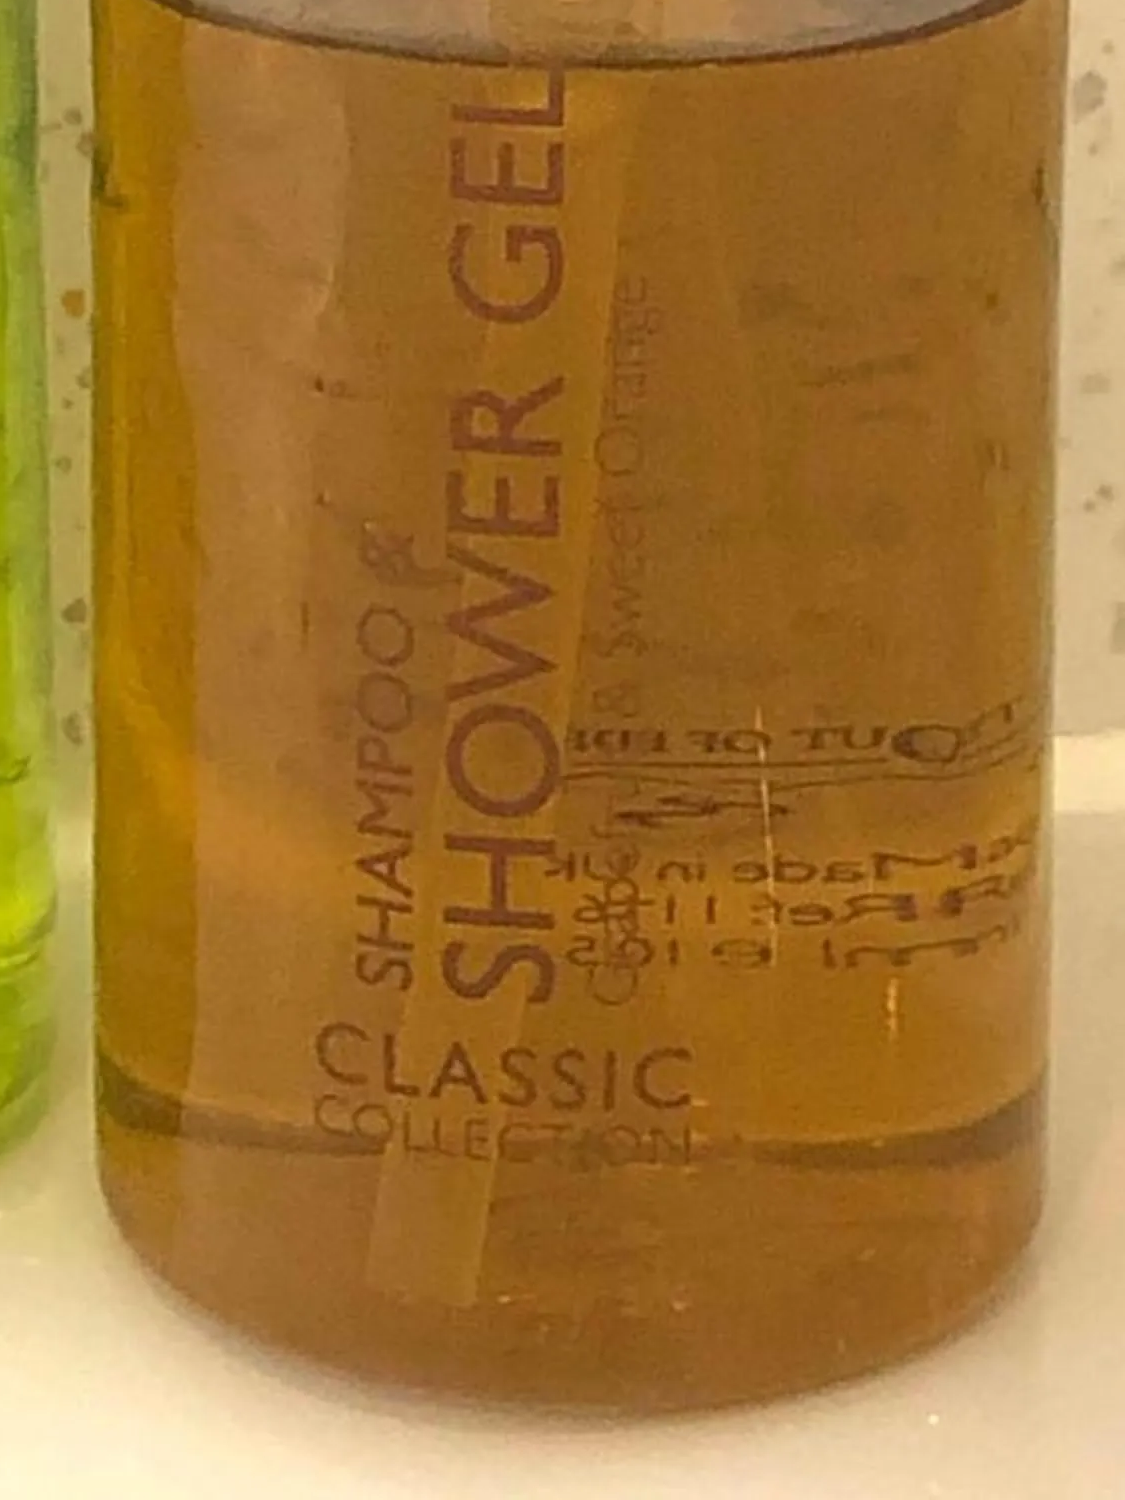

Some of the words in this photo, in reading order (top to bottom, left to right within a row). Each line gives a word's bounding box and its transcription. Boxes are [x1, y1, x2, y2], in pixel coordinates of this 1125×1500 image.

[447, 57, 566, 325] GEL
[593, 275, 661, 479] Orange
[441, 374, 565, 1005] SHOWER
[590, 497, 647, 659] Sweet
[355, 605, 415, 993] SHAMPOO
[314, 1021, 693, 1112] CLASSIC
